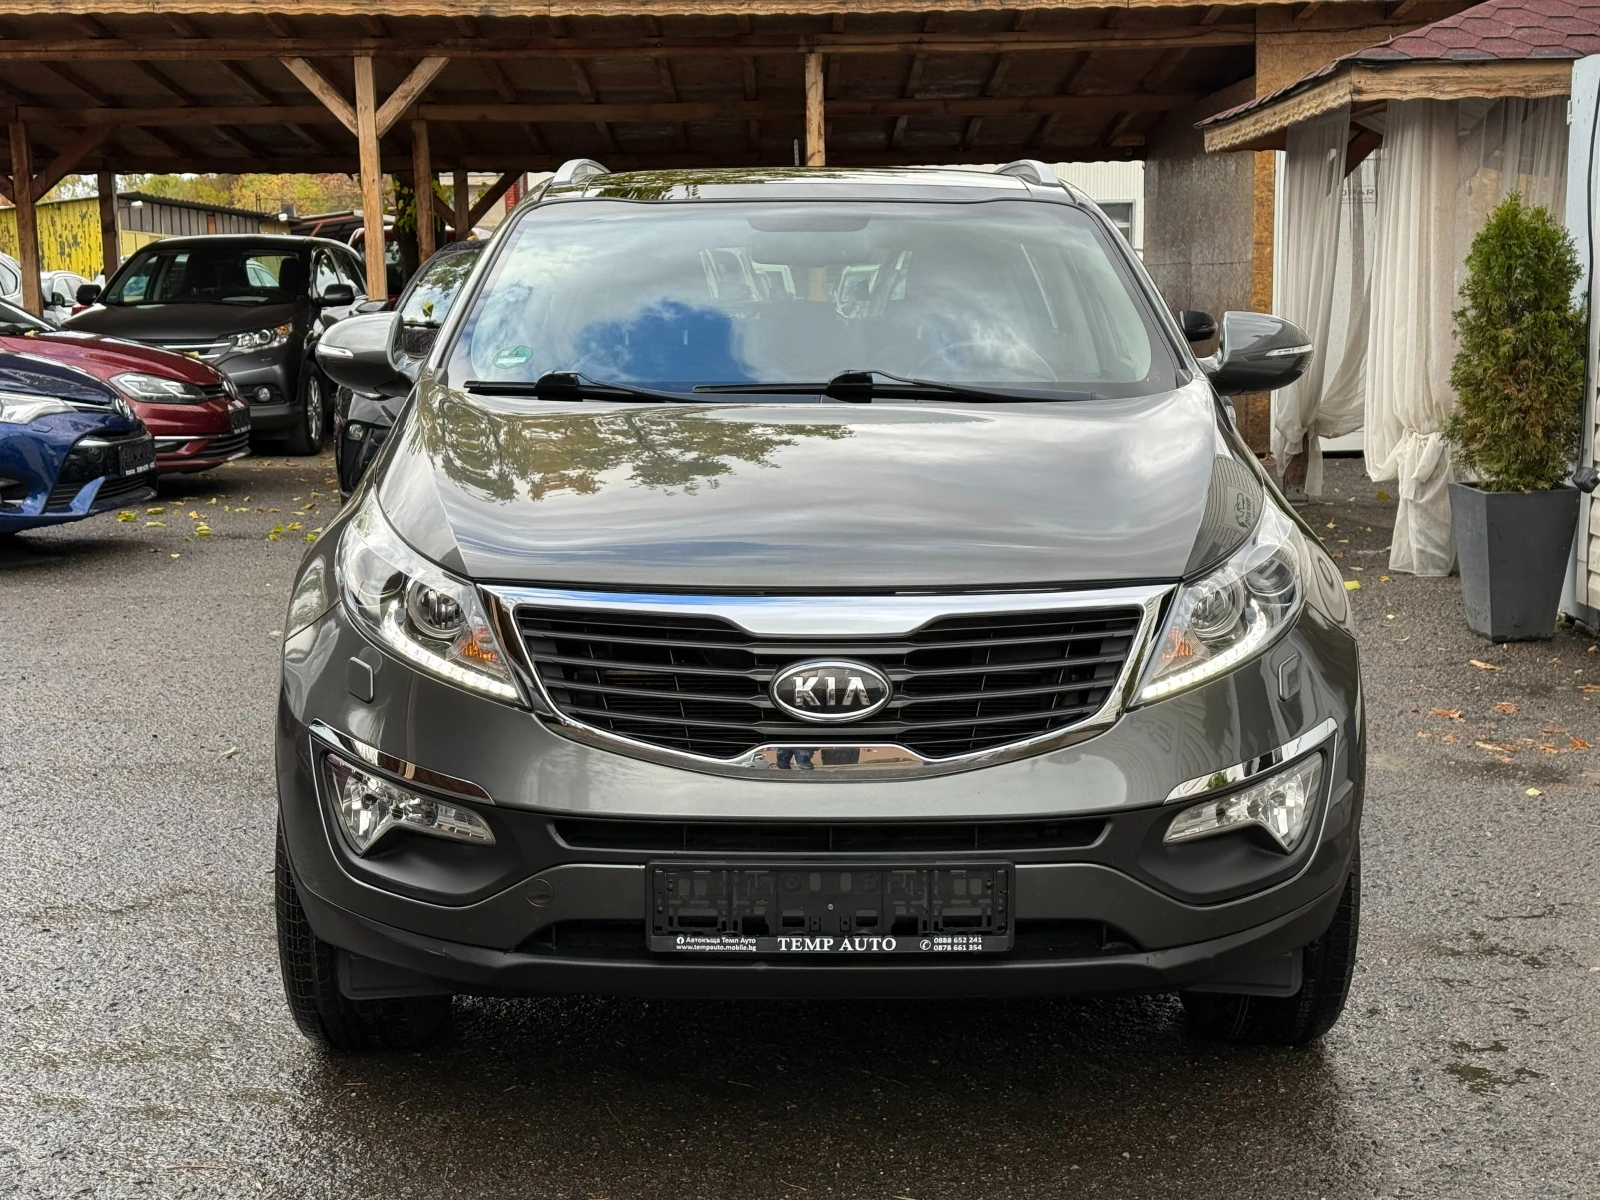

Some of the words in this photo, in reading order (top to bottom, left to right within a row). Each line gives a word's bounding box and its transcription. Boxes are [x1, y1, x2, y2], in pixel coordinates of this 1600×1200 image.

[792, 676, 871, 706] KIA
[740, 937, 756, 945] Ауто
[777, 937, 834, 951] TEMP
[838, 937, 897, 951] AUTO
[675, 944, 757, 952] www.tempauto.mobile.bg
